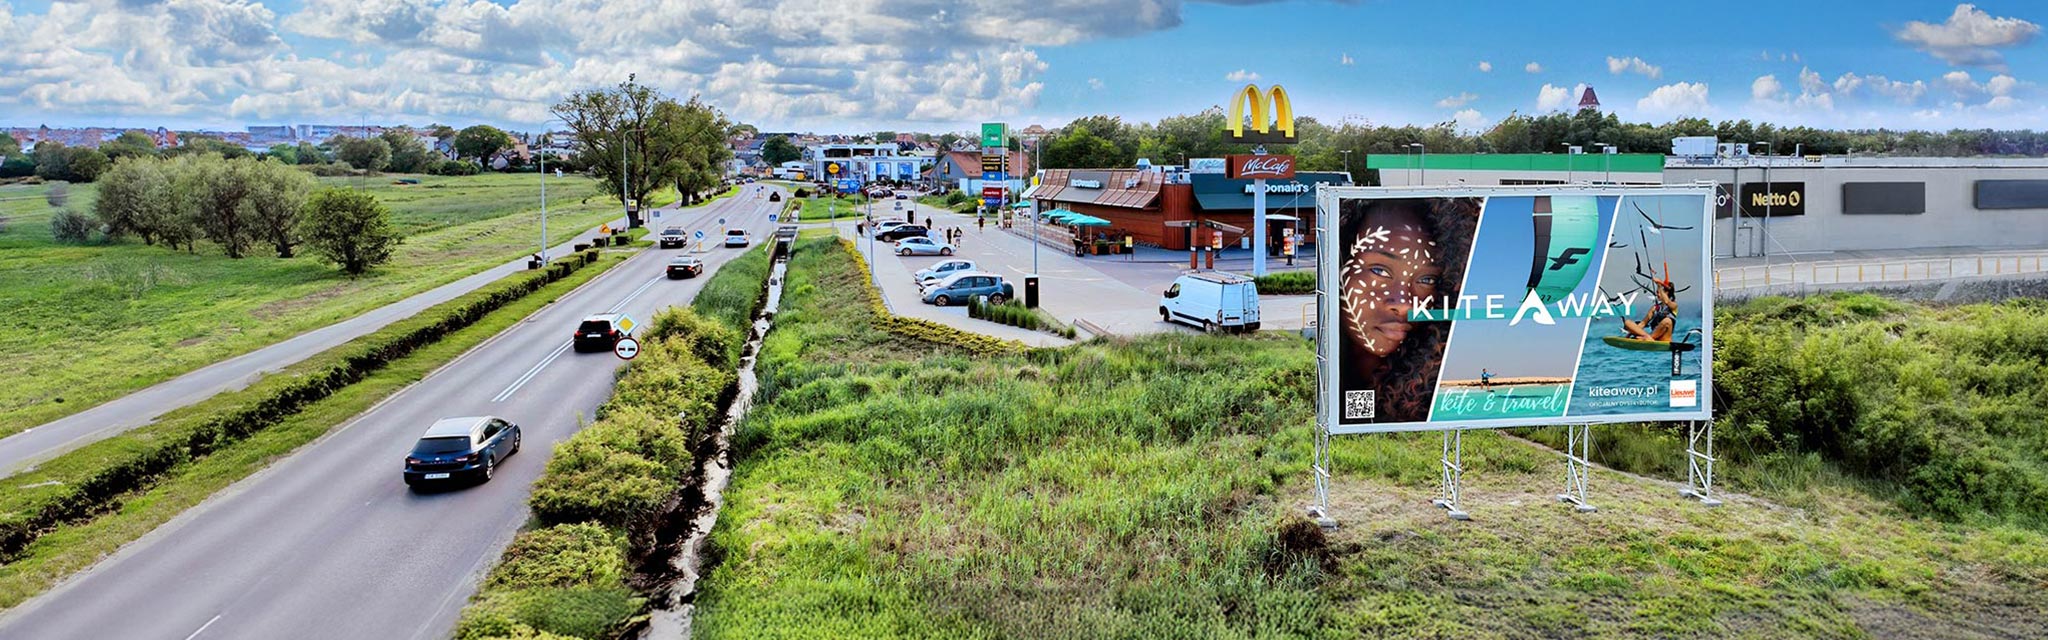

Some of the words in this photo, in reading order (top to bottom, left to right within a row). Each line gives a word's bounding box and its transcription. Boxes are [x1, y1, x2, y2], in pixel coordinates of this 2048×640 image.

[1245, 184, 1310, 193] MDonald's
[1752, 192, 1787, 206] Netto
[1589, 384, 1658, 398] kiteaway.pl
[1440, 388, 1478, 415] kite
[1483, 392, 1496, 411] &
[1501, 383, 1564, 413] travel
